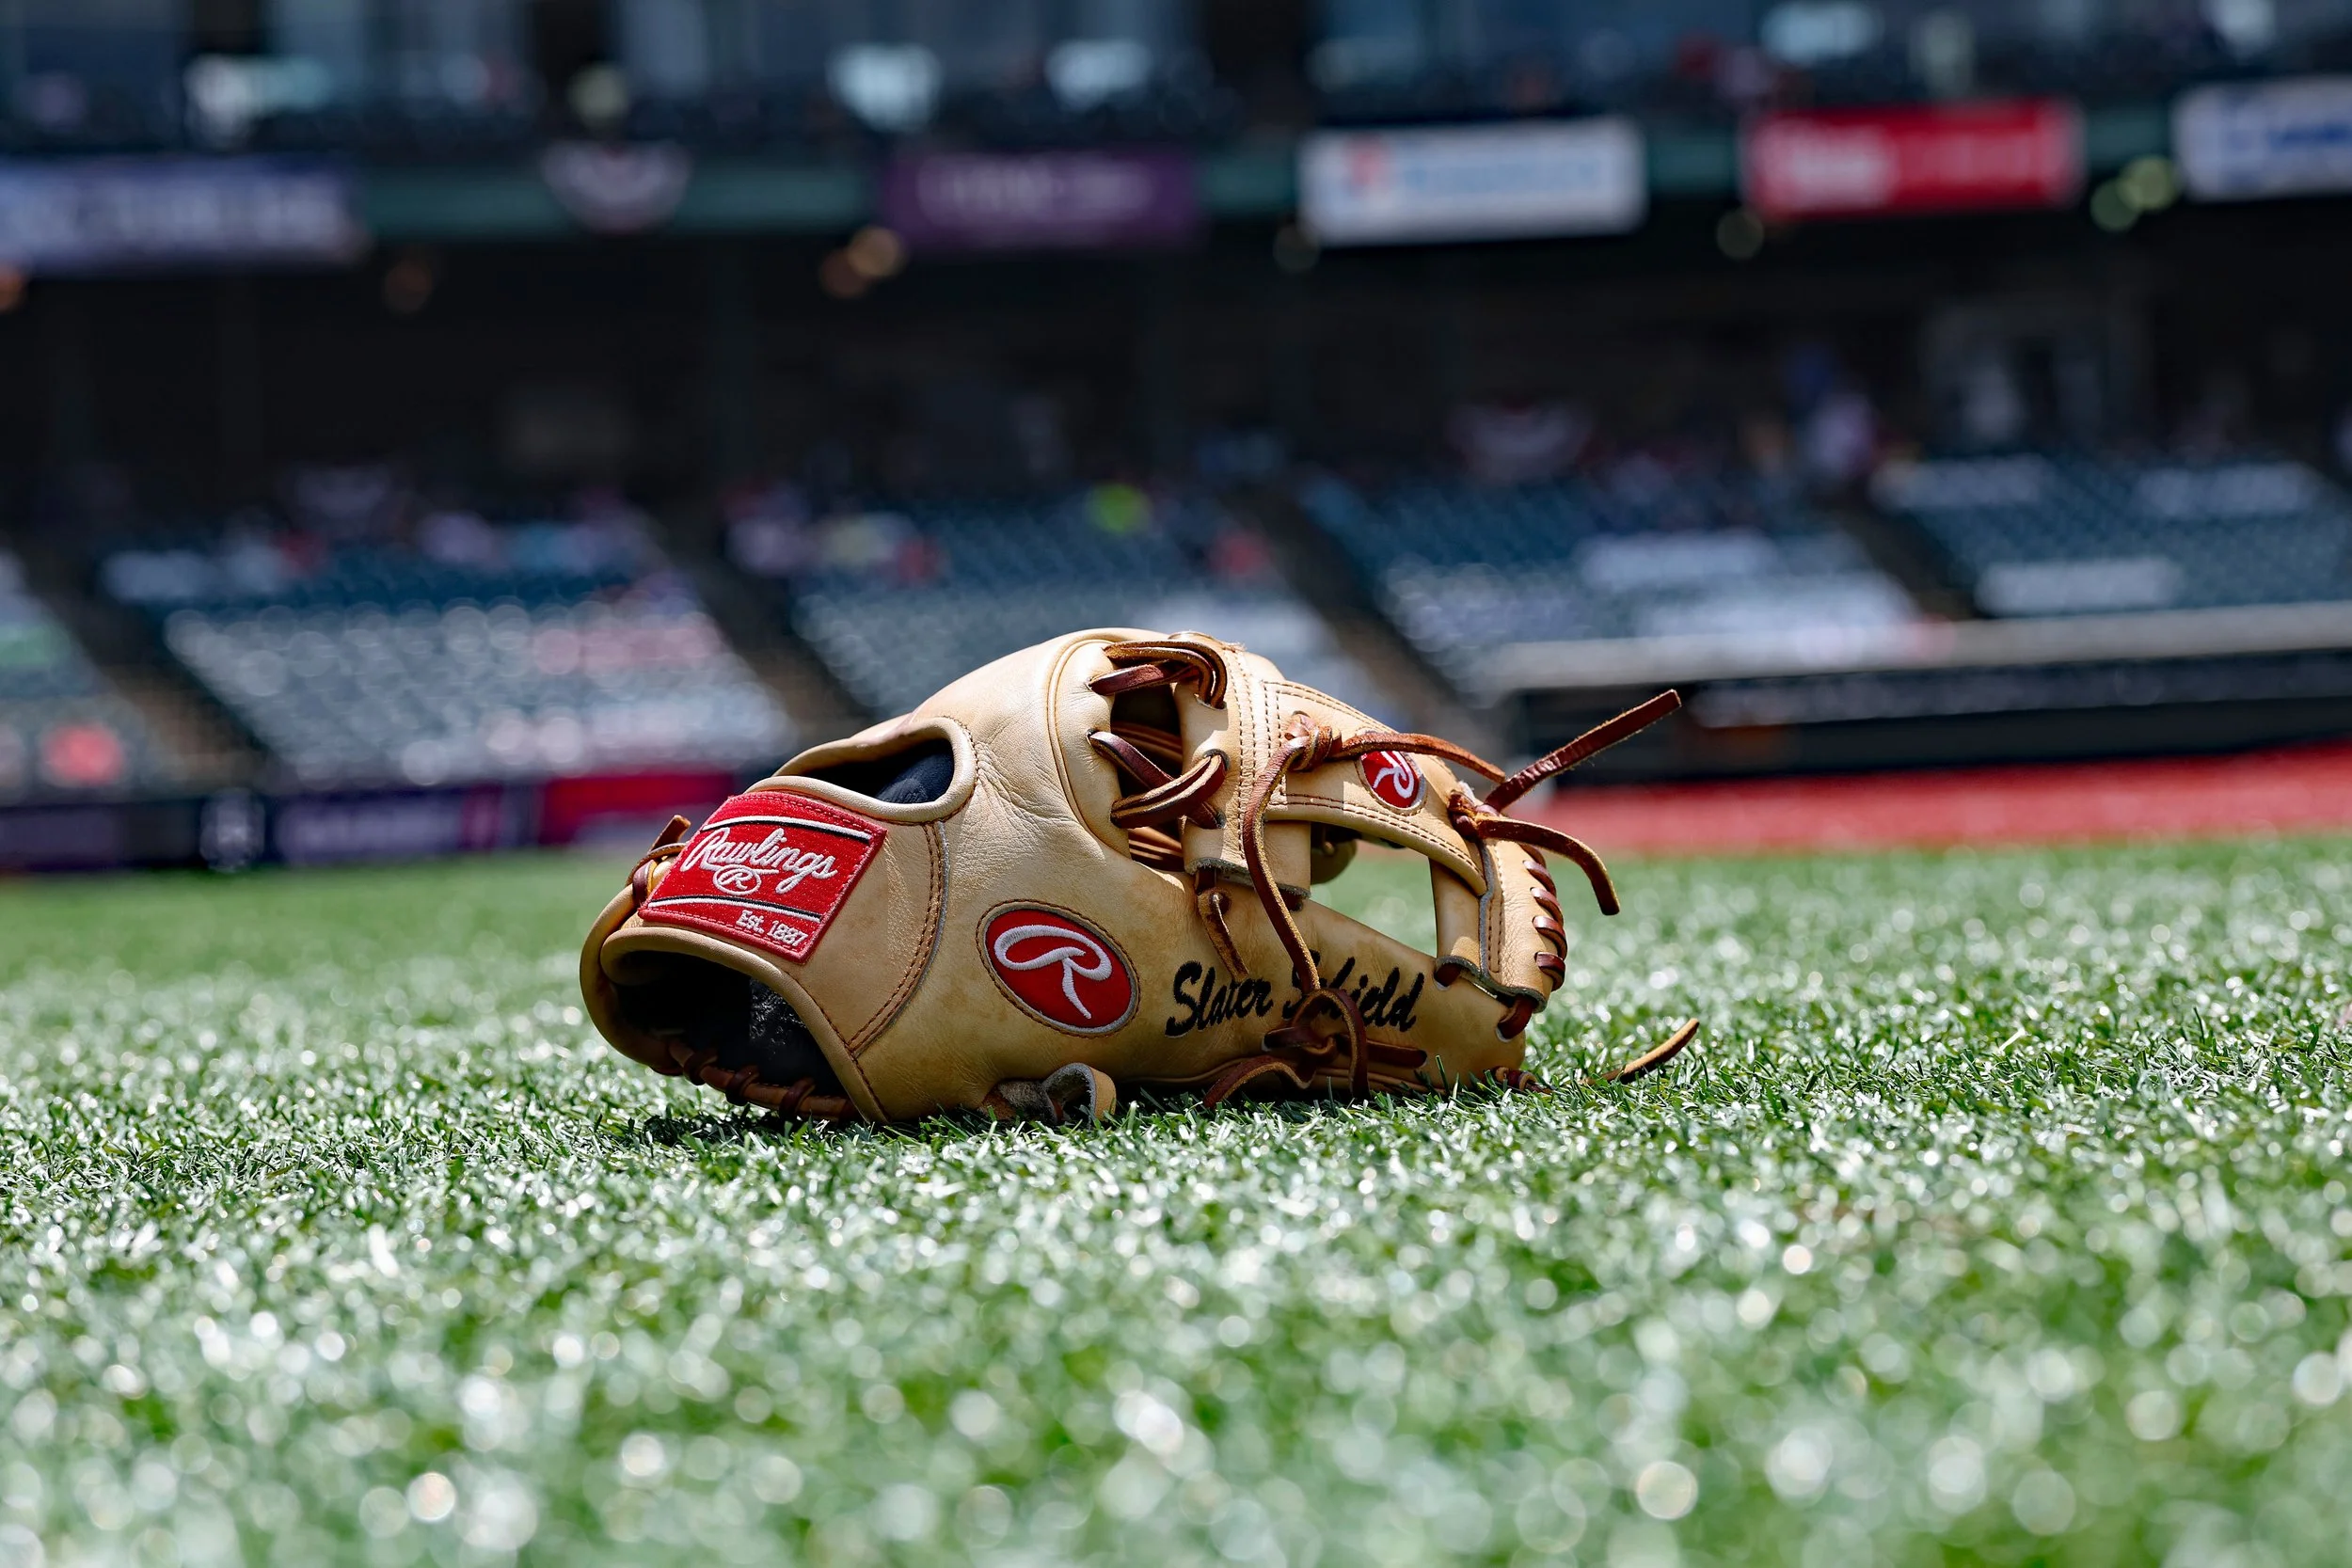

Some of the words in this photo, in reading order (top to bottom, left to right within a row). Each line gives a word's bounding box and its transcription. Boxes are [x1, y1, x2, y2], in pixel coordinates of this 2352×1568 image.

[680, 827, 837, 895] Rawlings
[736, 910, 765, 934] Est.
[767, 920, 809, 947] 1887
[1165, 960, 1274, 1038] Slater
